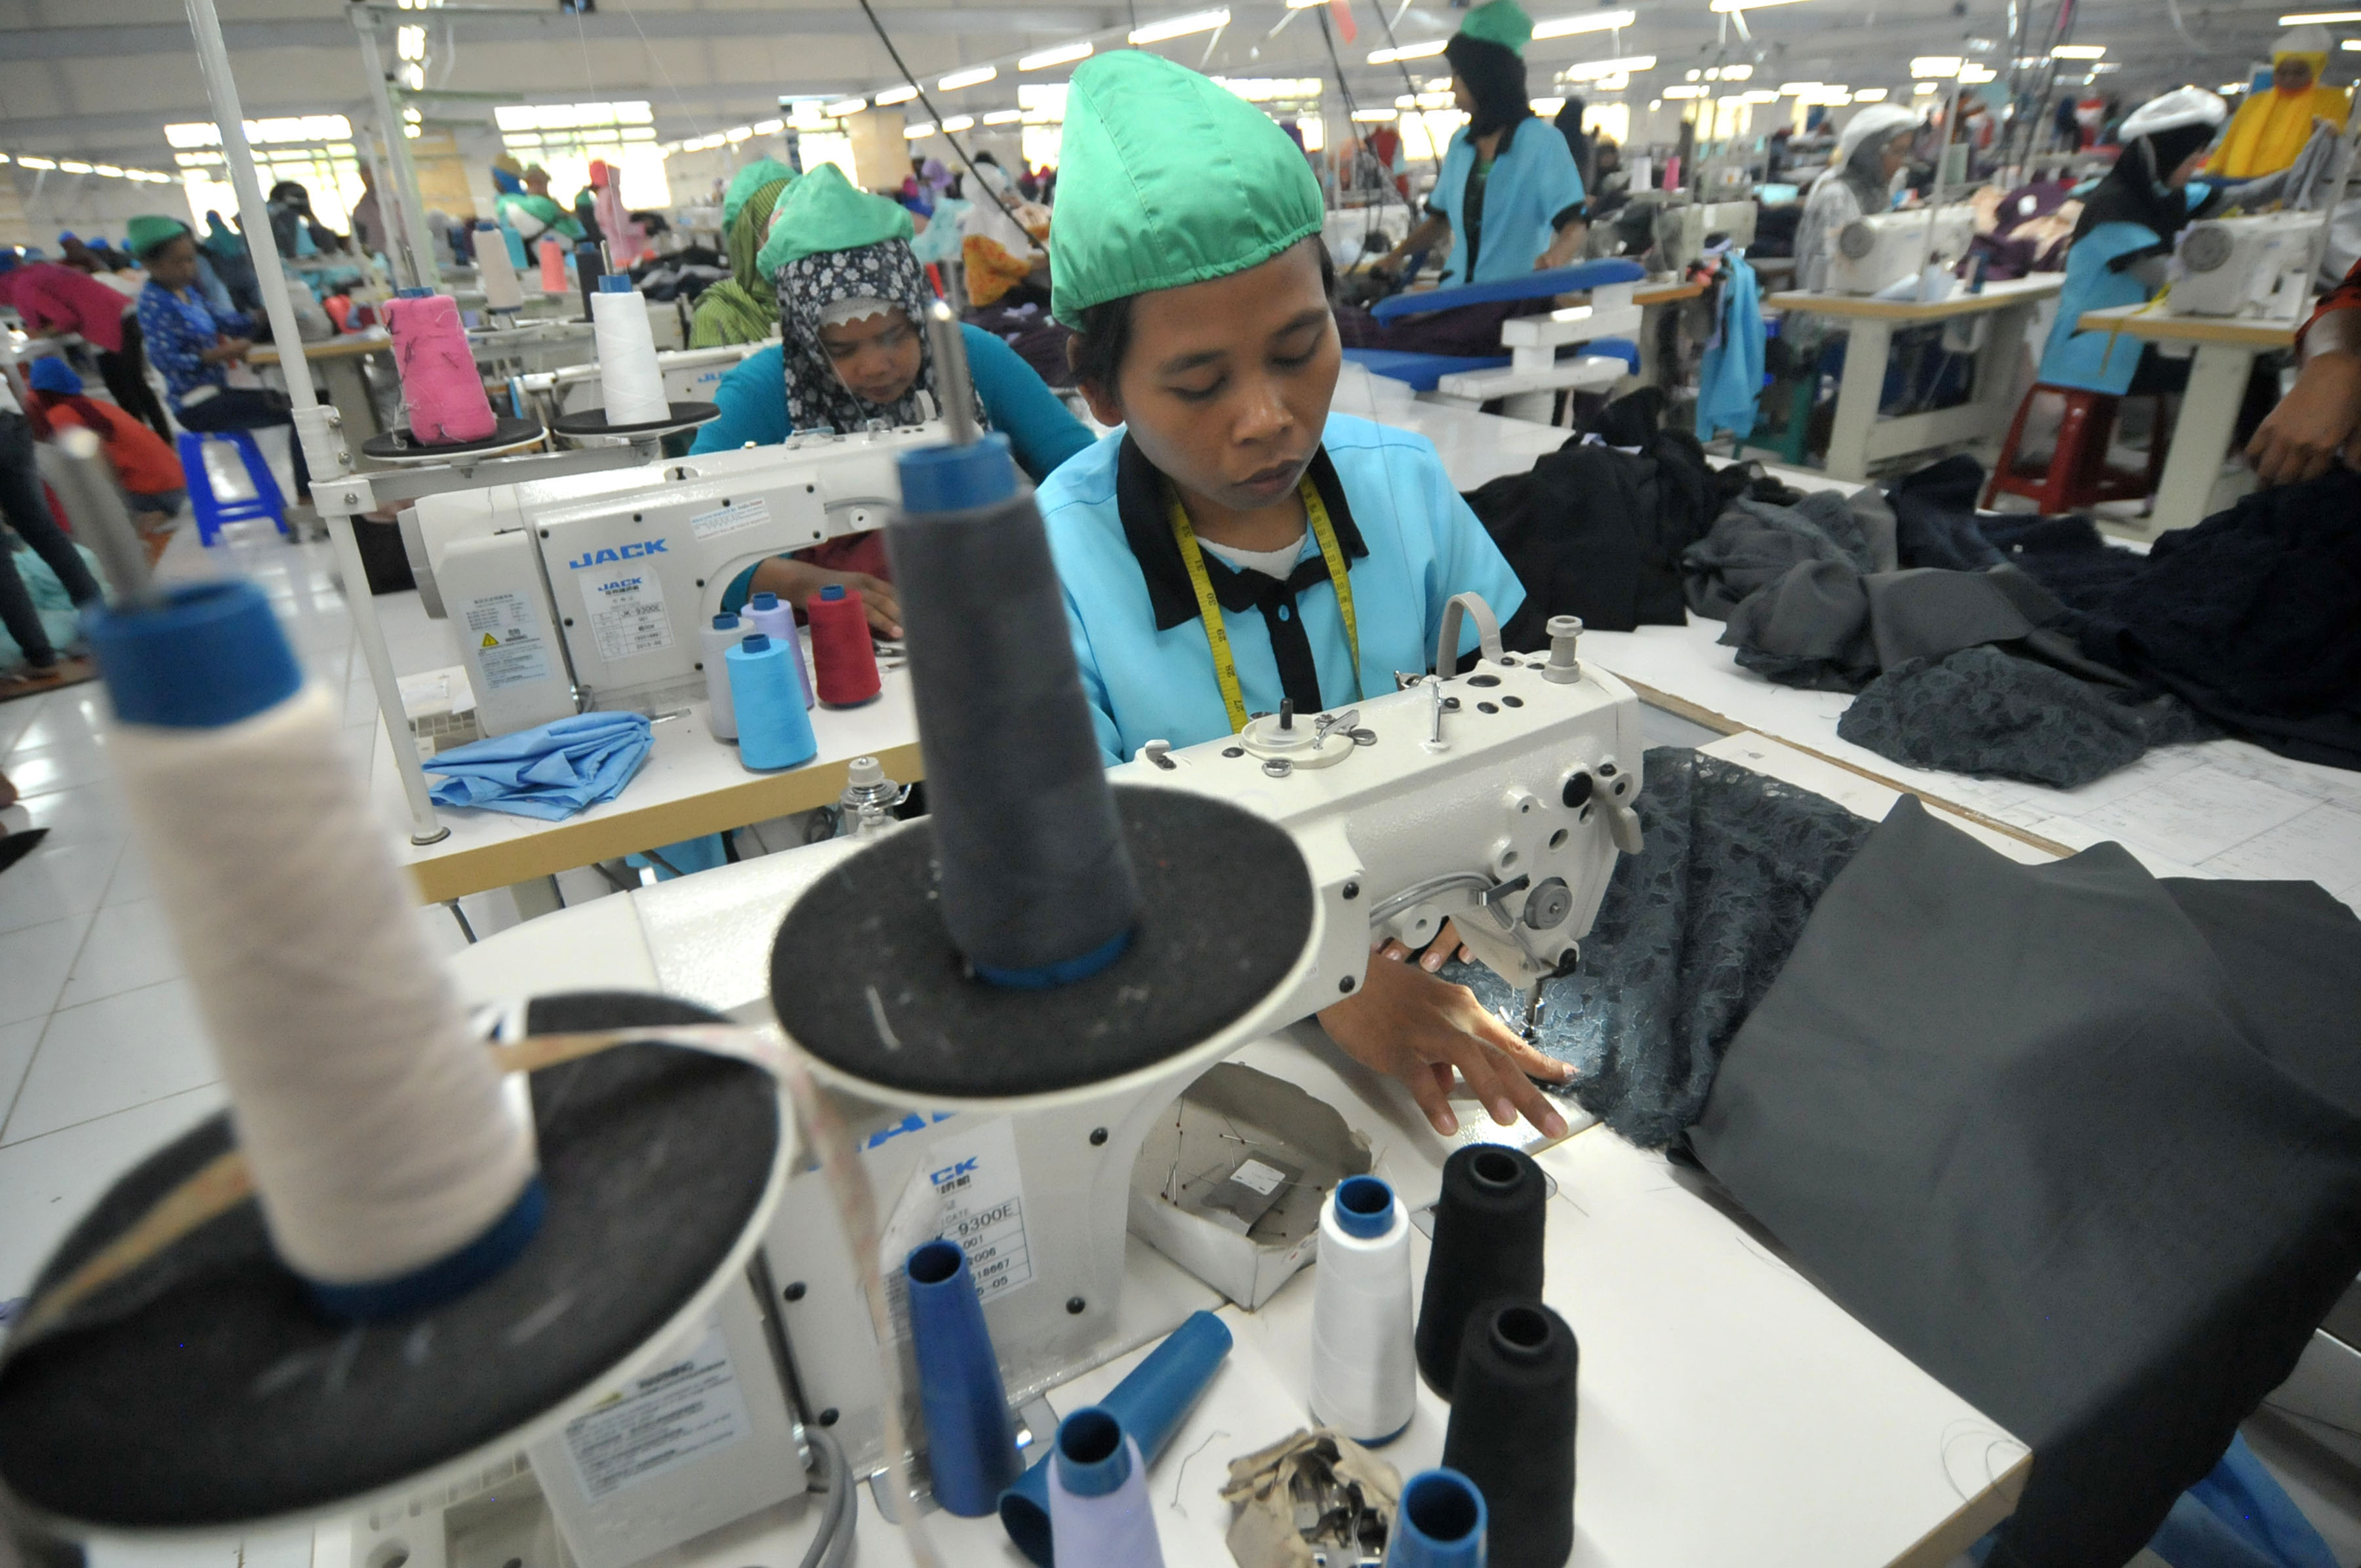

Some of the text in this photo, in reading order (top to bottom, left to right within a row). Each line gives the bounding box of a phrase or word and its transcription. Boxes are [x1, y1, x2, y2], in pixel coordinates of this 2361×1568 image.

[569, 538, 668, 569] JACK
[597, 577, 643, 592] JACK
[1207, 592, 1217, 607] 30
[1217, 628, 1226, 643] 29
[1225, 664, 1235, 677] 28
[1234, 700, 1244, 712] 27
[963, 1234, 982, 1249] 001
